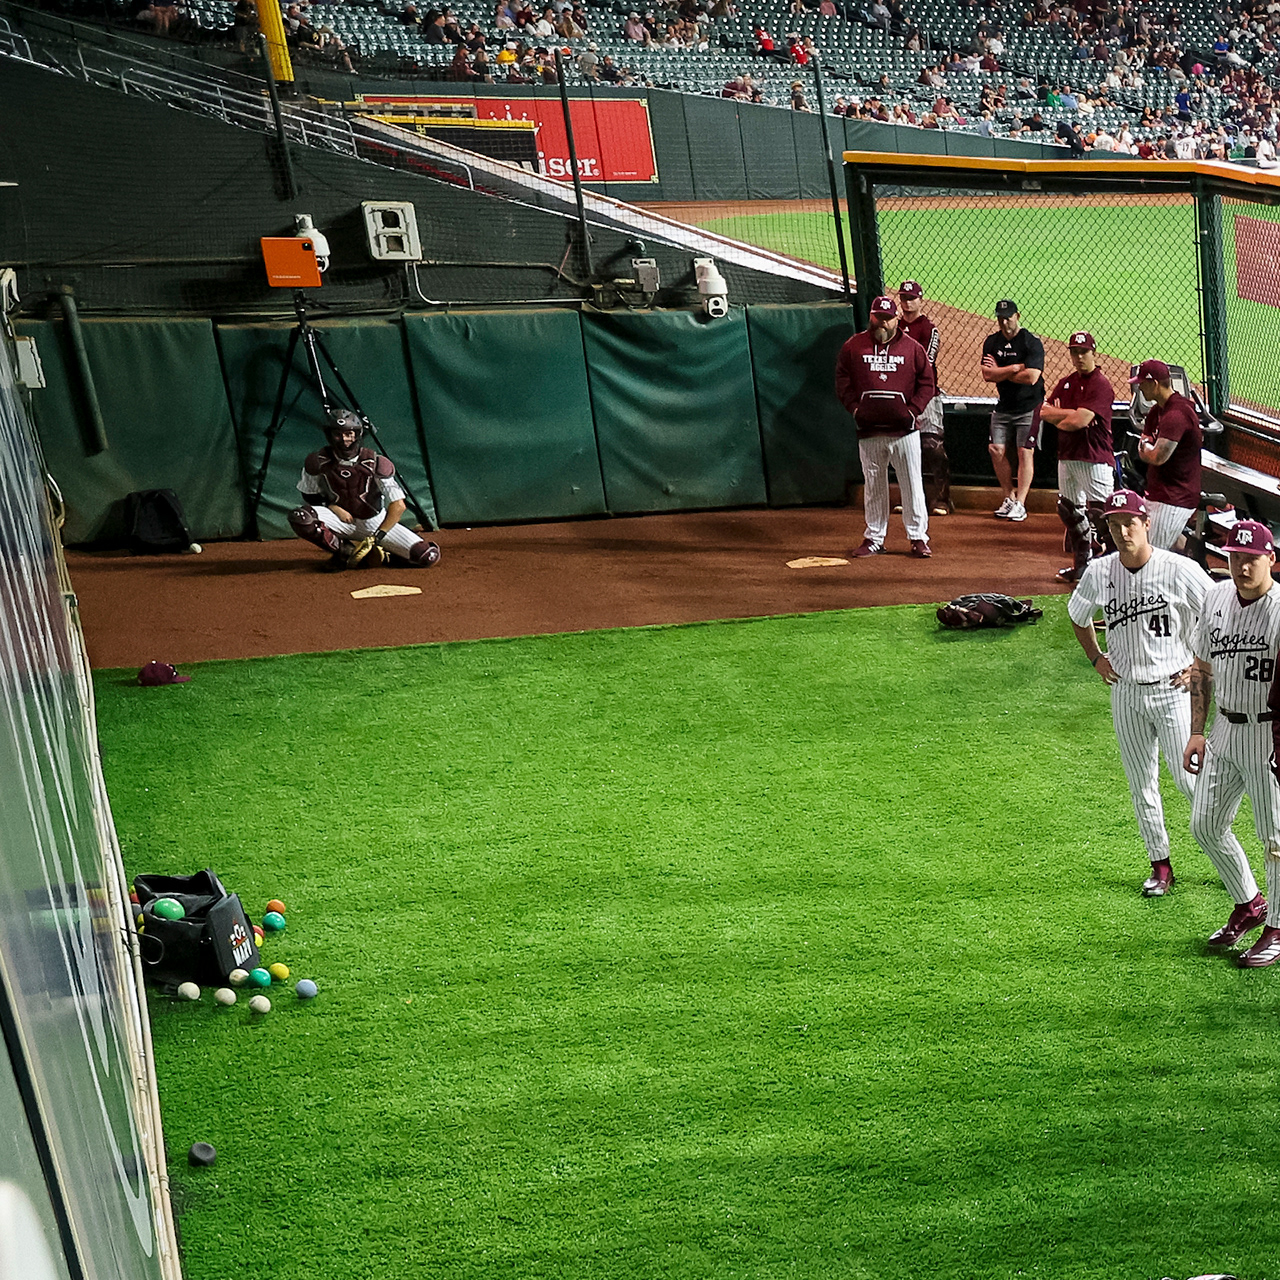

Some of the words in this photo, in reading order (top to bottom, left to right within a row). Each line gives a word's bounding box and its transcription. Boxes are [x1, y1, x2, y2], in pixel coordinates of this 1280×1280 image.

[862, 354, 888, 365] TEXAS
[870, 362, 898, 373] AGGIES
[1104, 593, 1168, 627] Aggies
[1148, 614, 1172, 638] 41
[1209, 627, 1270, 660] Aggies
[1244, 655, 1275, 683] 28
